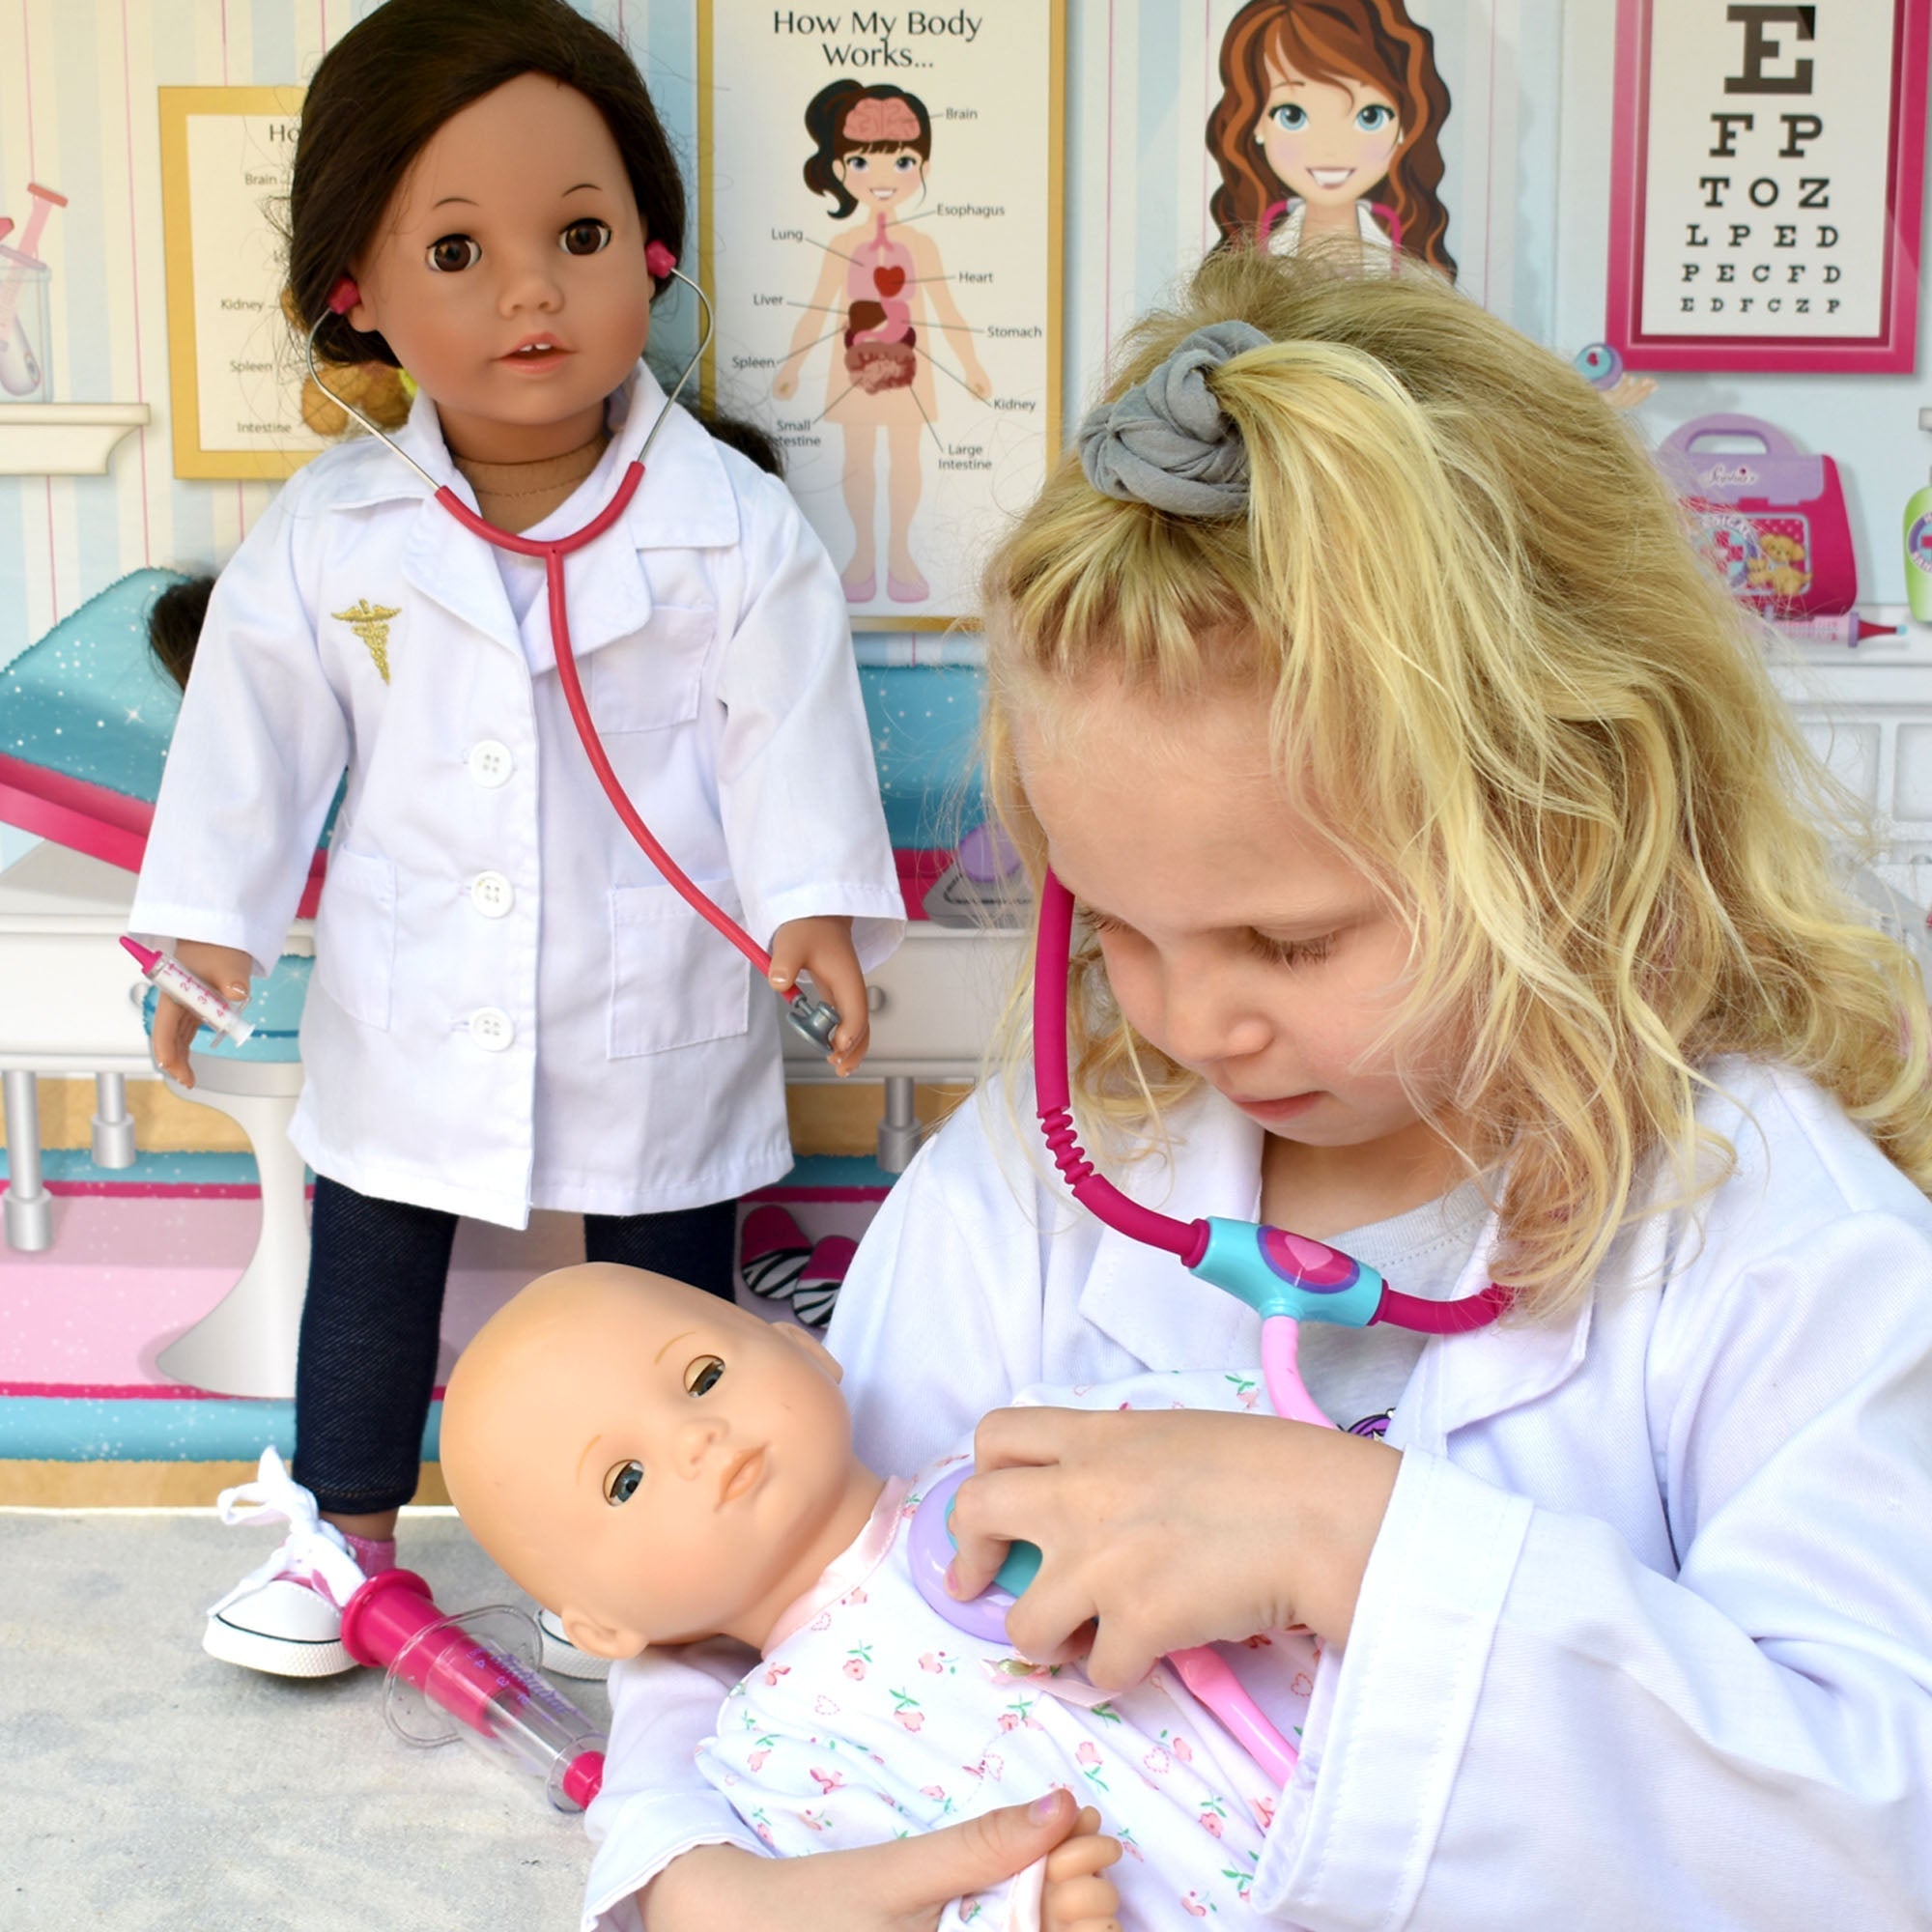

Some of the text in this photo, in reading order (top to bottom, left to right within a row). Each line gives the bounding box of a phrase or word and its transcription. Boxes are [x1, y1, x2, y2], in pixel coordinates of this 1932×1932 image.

[775, 10, 981, 43] How My Body
[822, 42, 932, 67] Works...
[1724, 5, 1816, 95] E
[946, 107, 978, 120] Brain
[269, 125, 299, 142] Ho
[1710, 113, 1823, 158] F P
[244, 174, 277, 186] Brain
[1700, 177, 1830, 209] T O Z
[937, 204, 1005, 218] Esophagus
[772, 228, 803, 242] Lung
[1687, 224, 1838, 248] L P E D
[959, 272, 992, 282] Heart
[221, 298, 265, 312] Kidney
[753, 294, 782, 306] Liver
[987, 327, 1042, 338] Stomach
[230, 360, 272, 374] Spleen
[732, 355, 775, 371] Spleen
[994, 399, 1036, 412] Kidney
[237, 421, 292, 434] Intestine
[777, 419, 810, 432] Small
[949, 444, 982, 458] Large
[939, 459, 992, 469] Intestine
